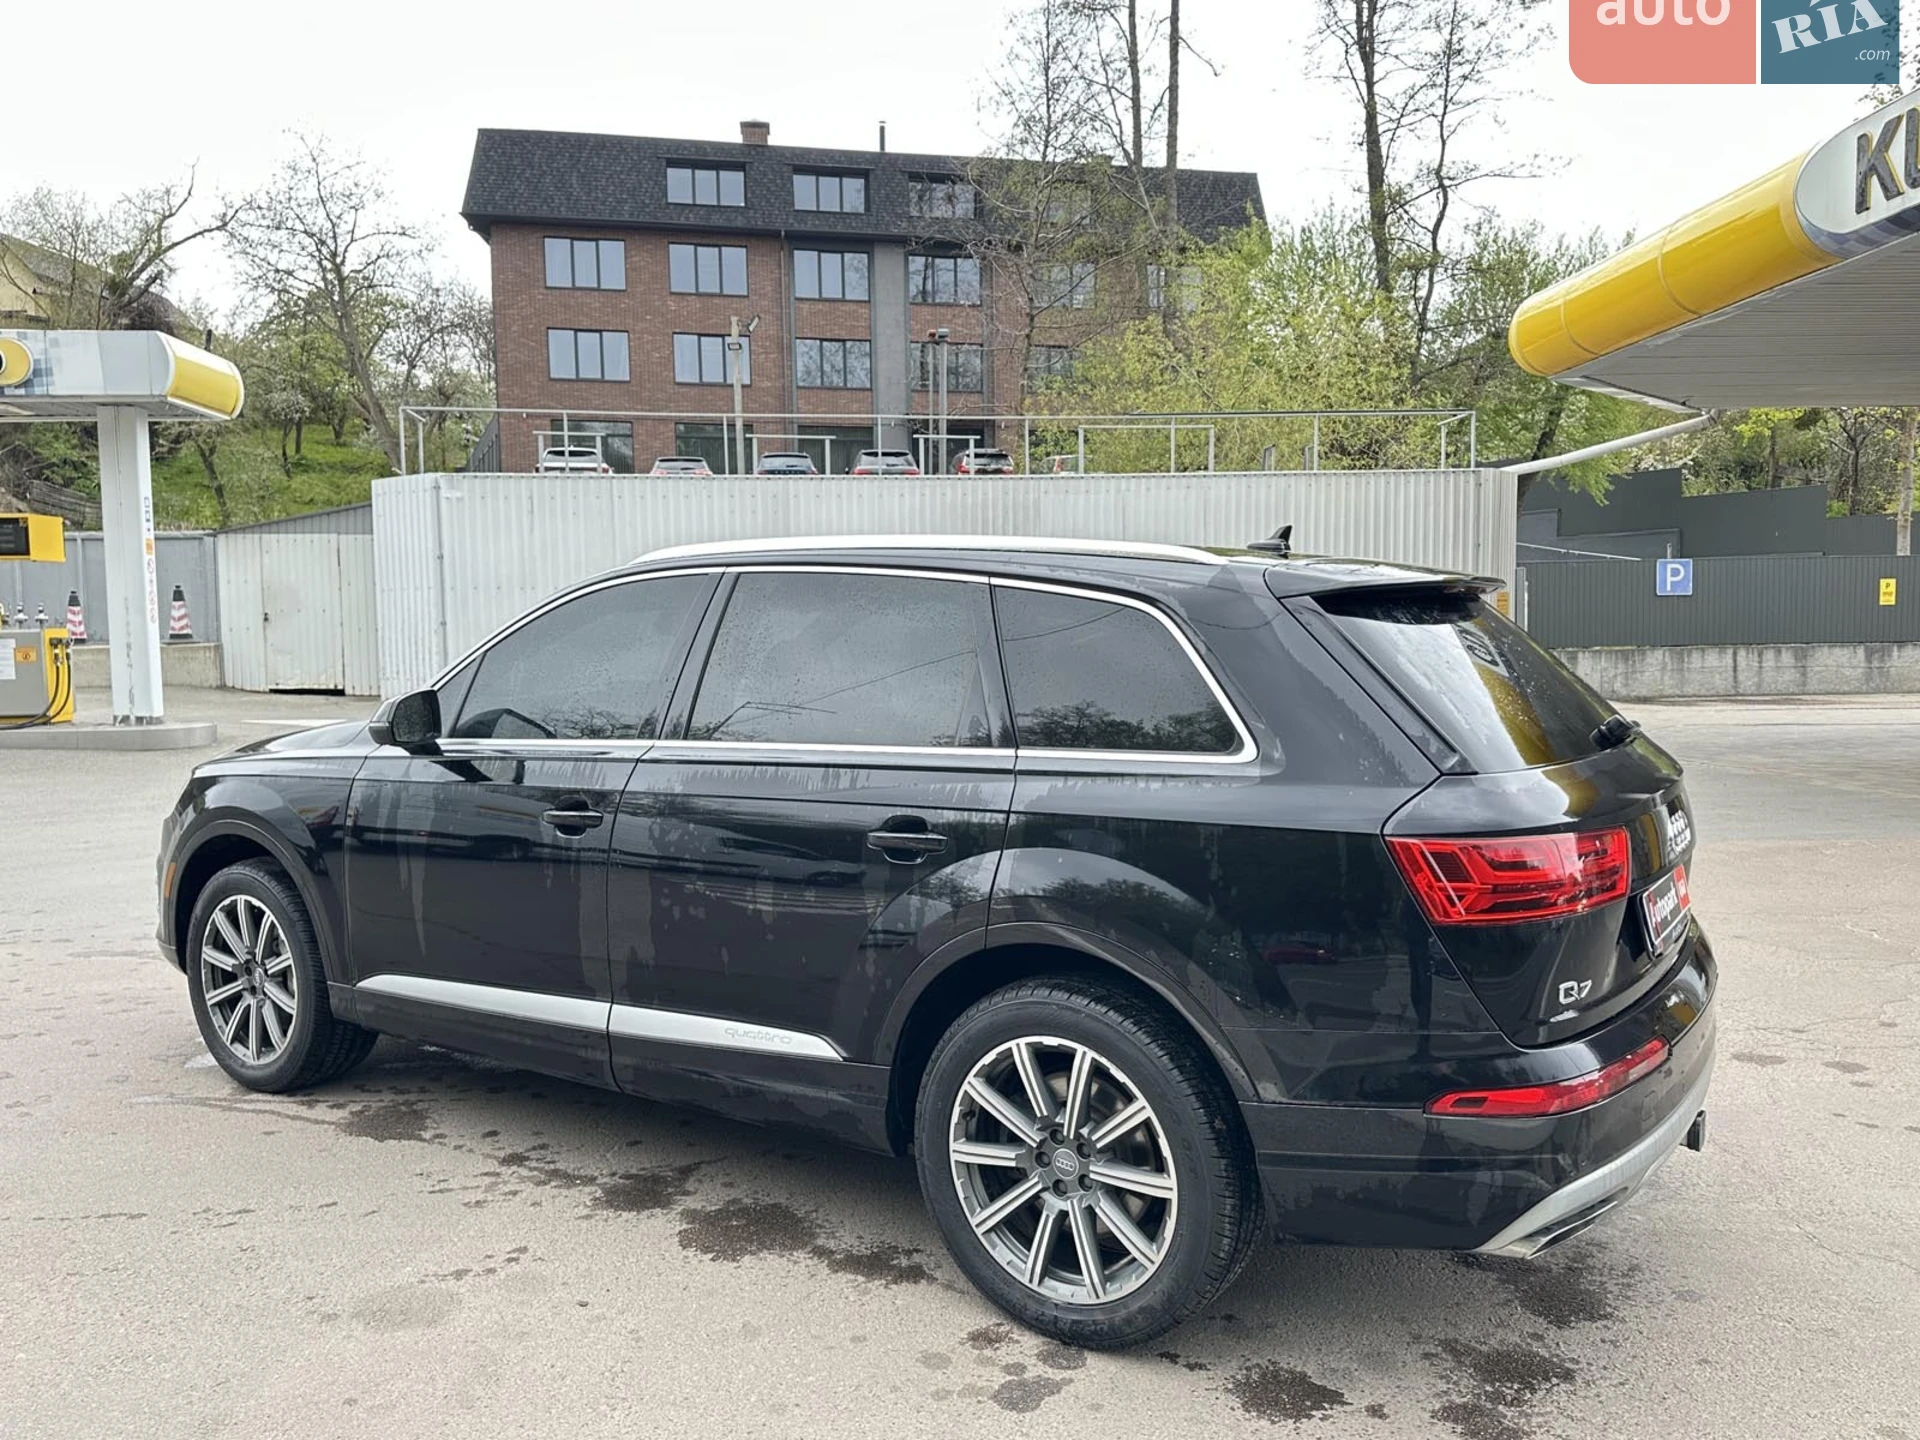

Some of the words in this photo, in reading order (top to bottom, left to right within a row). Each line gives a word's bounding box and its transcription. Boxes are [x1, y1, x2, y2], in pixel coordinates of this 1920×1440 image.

[1666, 564, 1685, 592] P
[1559, 979, 1592, 1005] Q7
[724, 1027, 792, 1045] quattro
